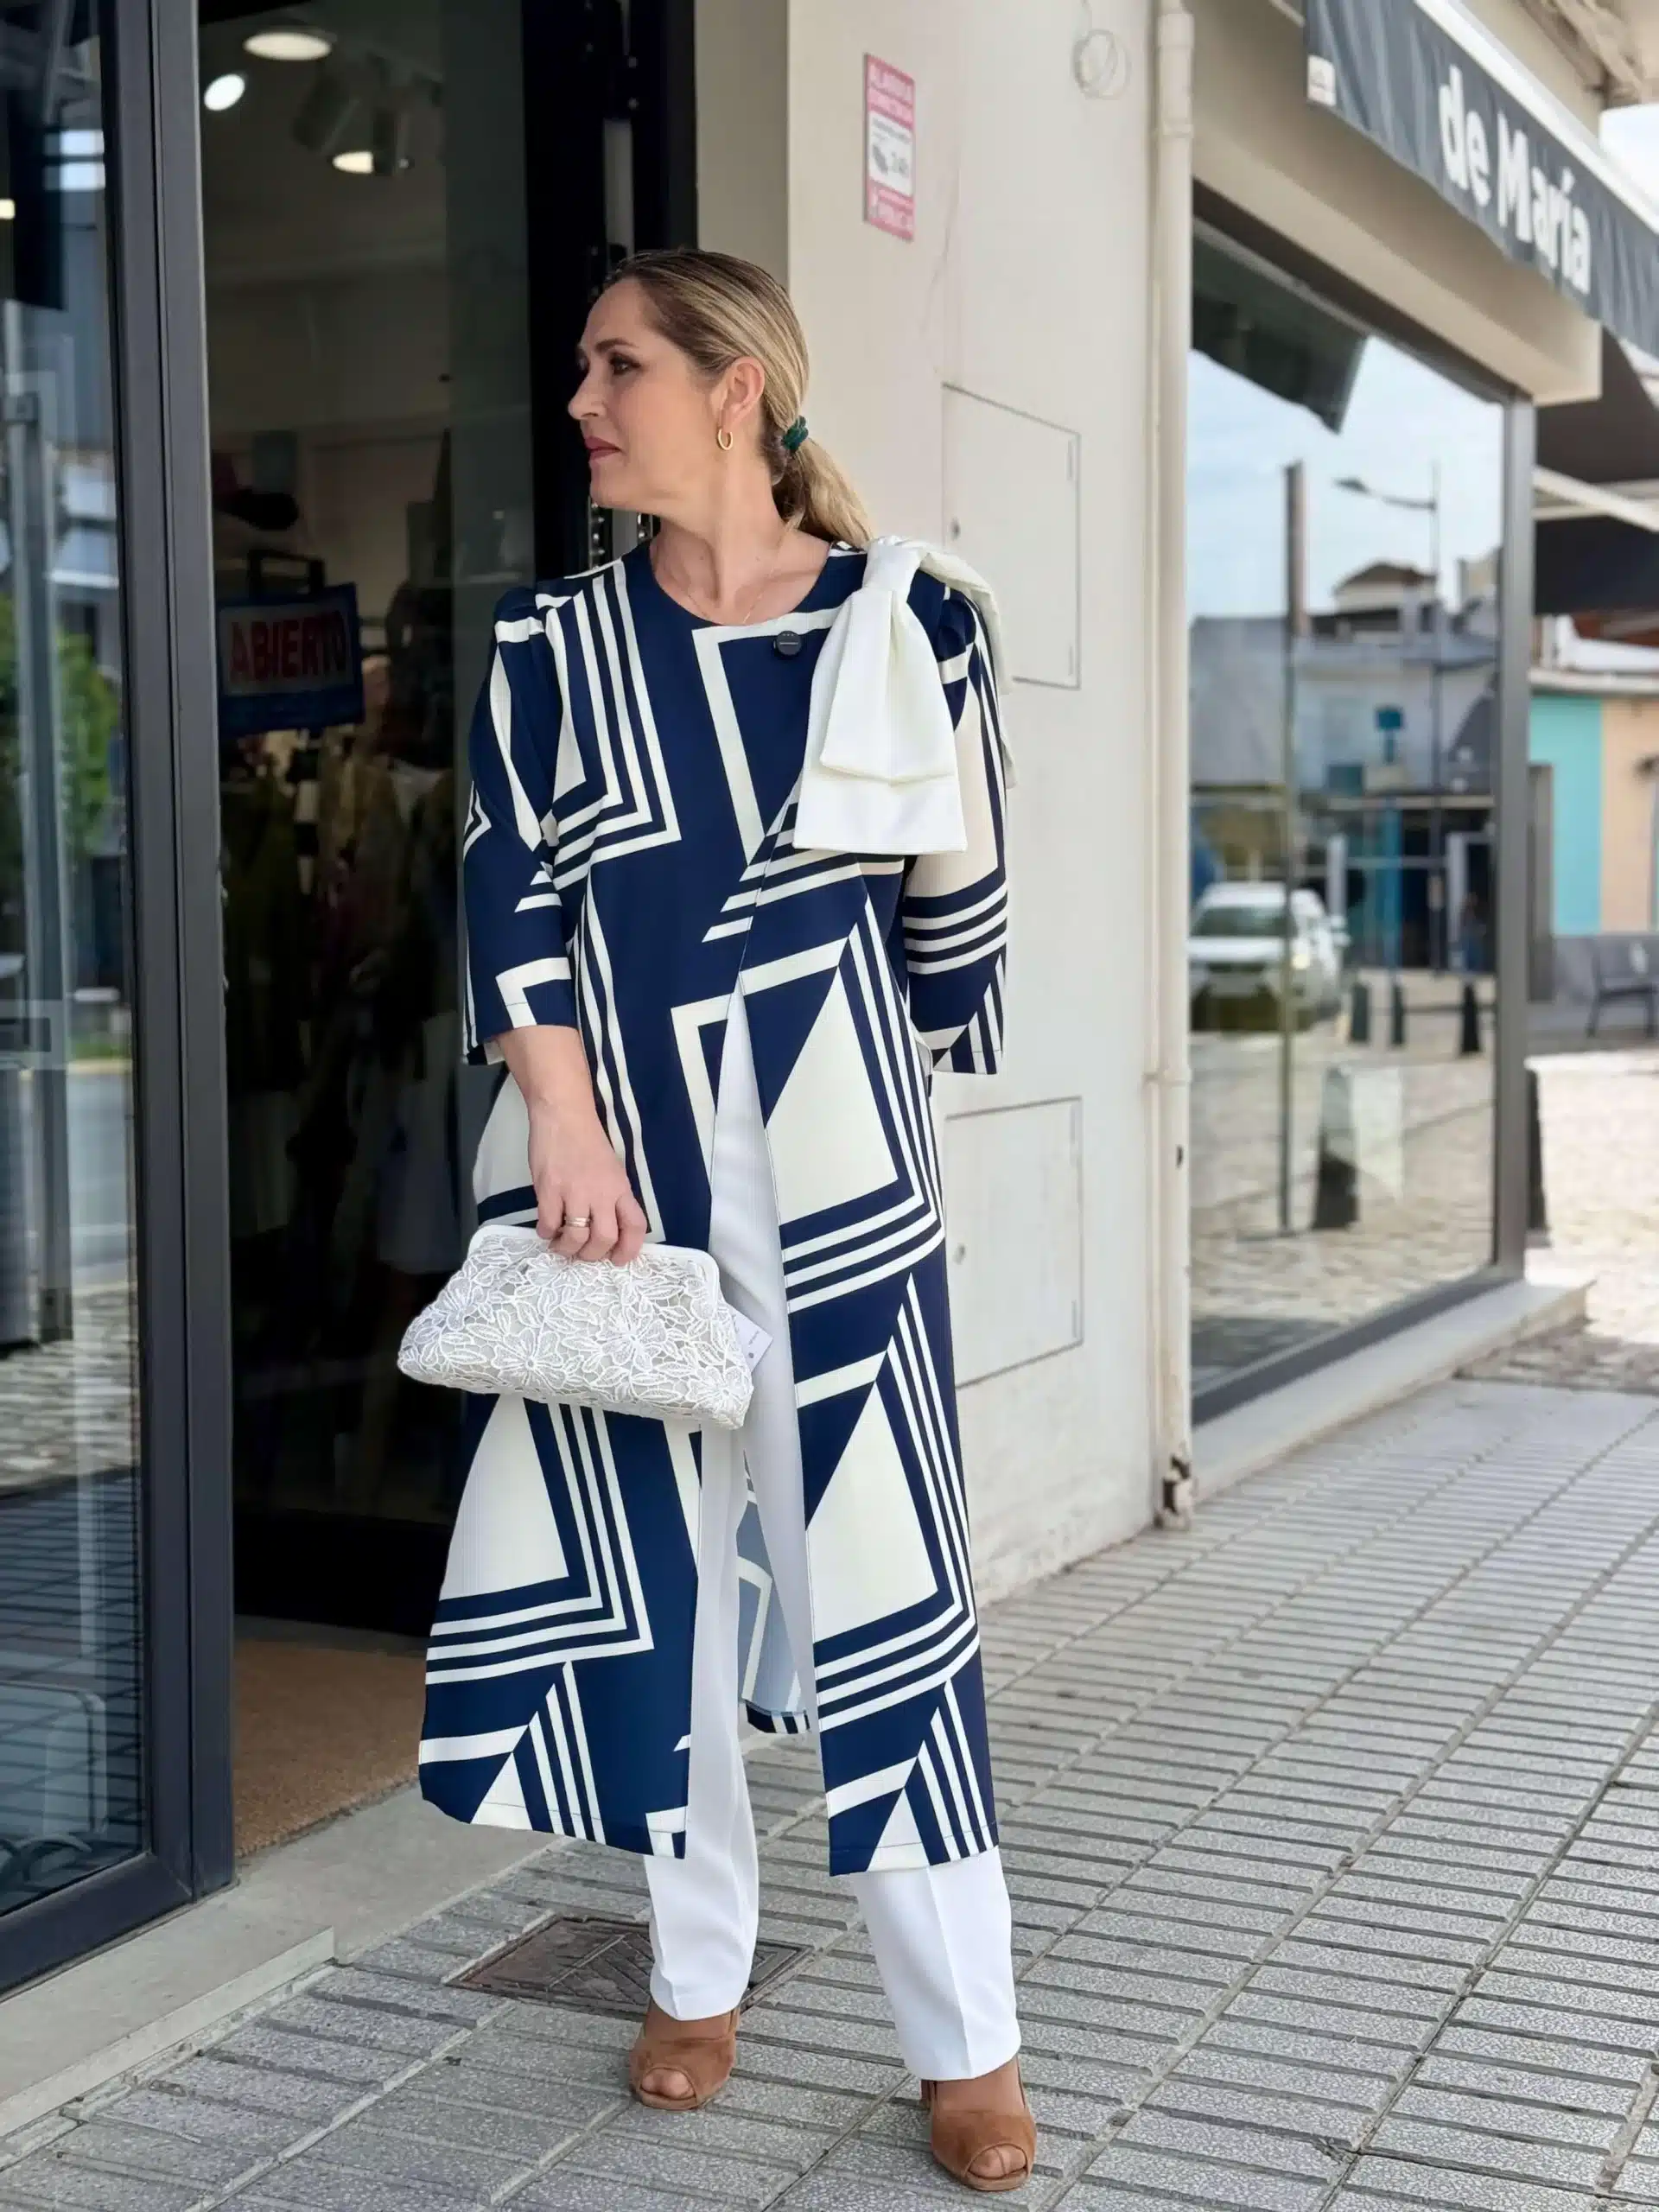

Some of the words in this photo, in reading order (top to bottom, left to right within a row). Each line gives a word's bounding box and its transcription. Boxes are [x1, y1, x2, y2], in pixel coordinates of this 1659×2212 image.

[1438, 64, 1491, 207] de
[1497, 111, 1592, 295] María
[230, 610, 347, 681] ABIERTO
